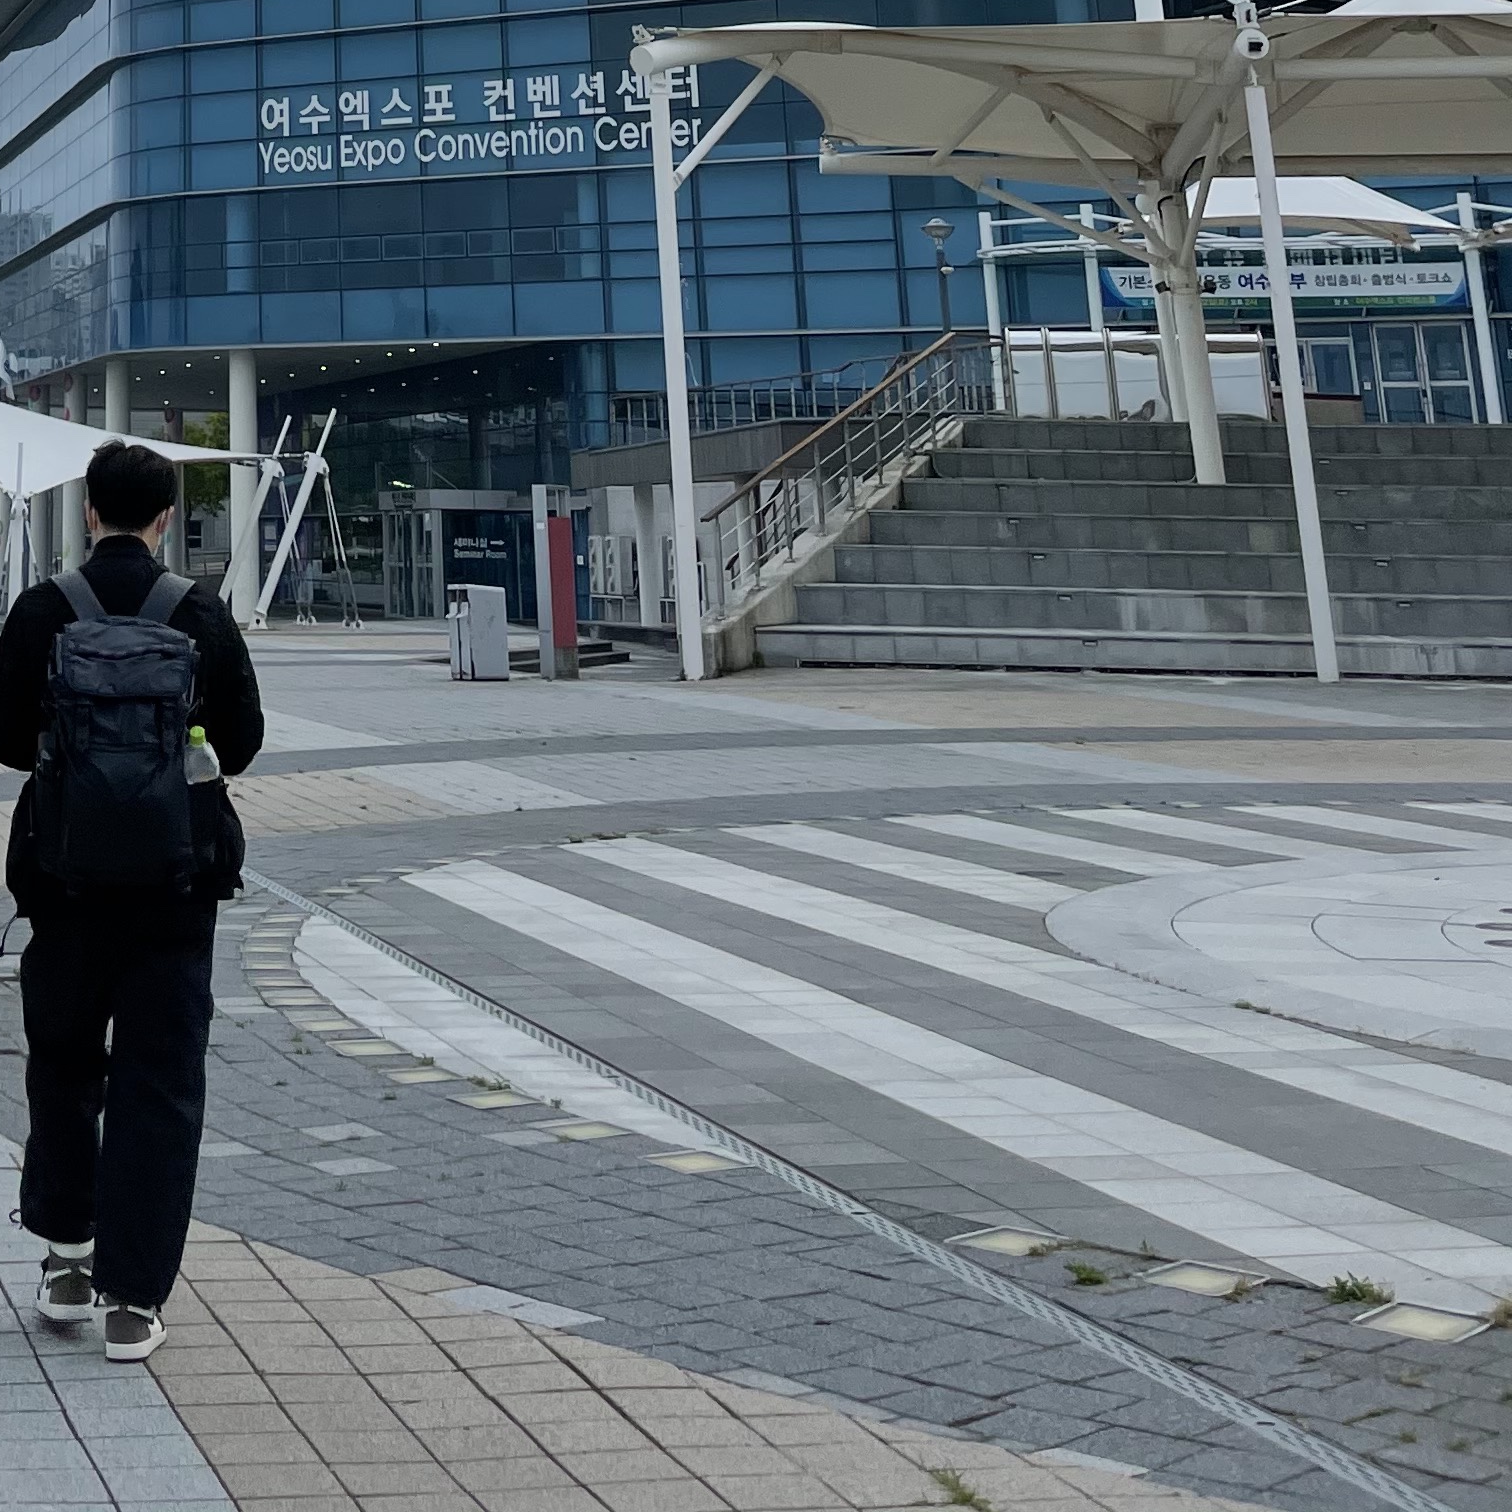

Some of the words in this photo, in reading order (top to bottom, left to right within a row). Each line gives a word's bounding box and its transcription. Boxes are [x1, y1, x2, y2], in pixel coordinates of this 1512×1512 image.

[260, 84, 456, 137] 여수엑스포
[482, 64, 700, 121] 컨벤션센터
[258, 141, 333, 174] Yeosu
[339, 134, 405, 172] Expo
[414, 120, 585, 163] Convention
[594, 116, 702, 152] Cener
